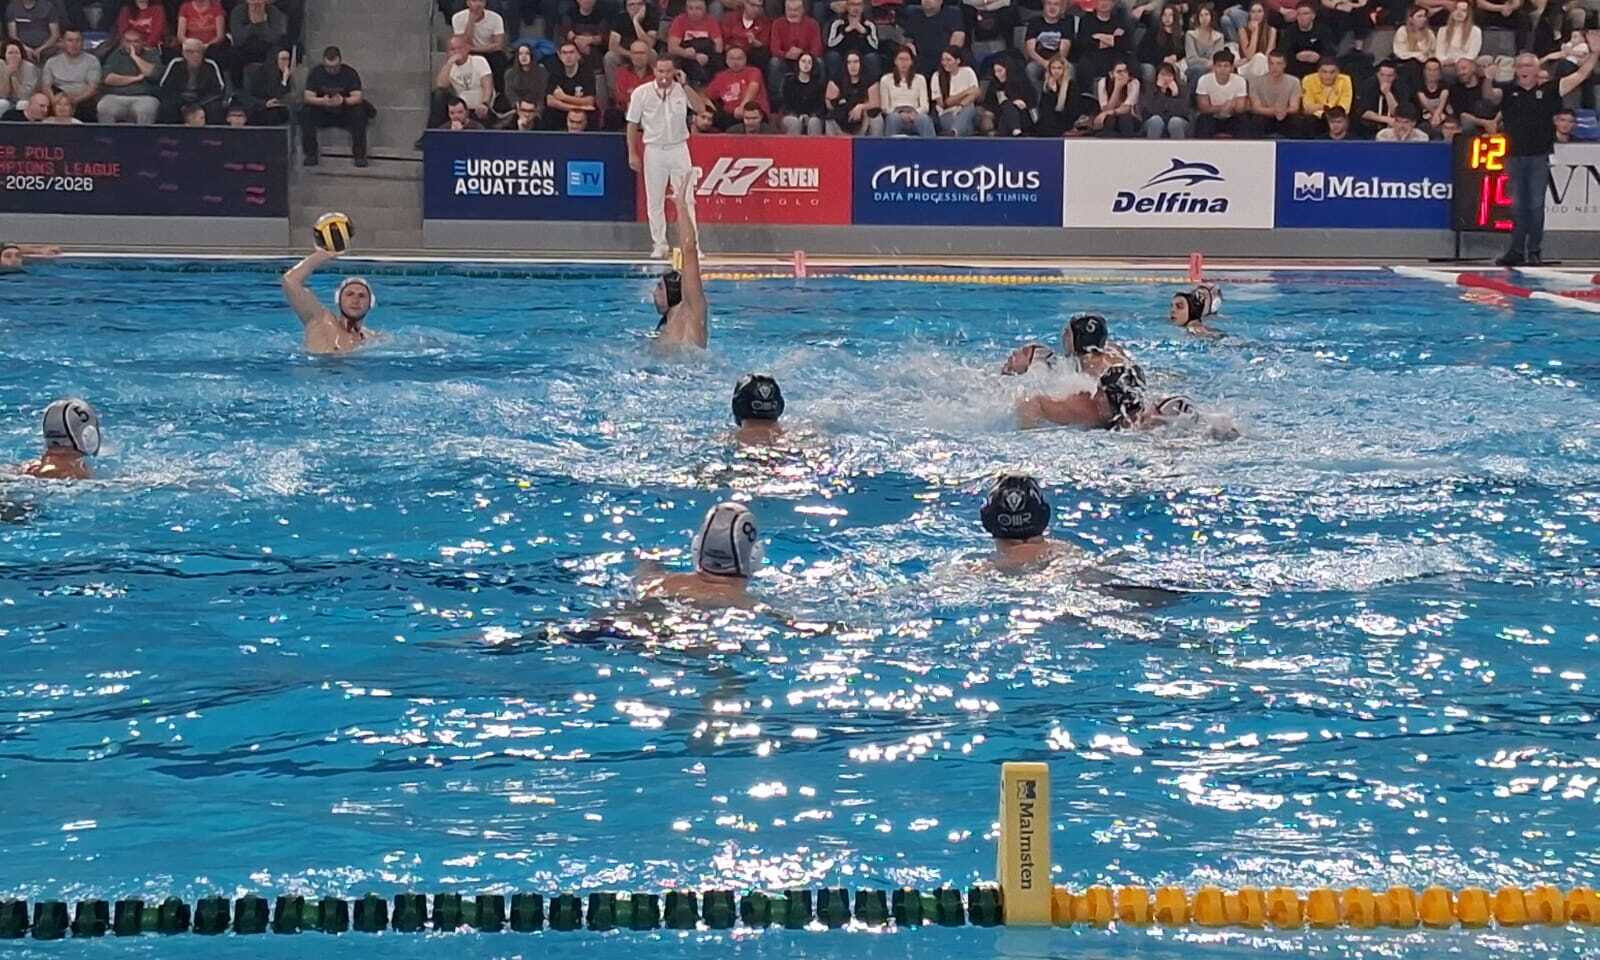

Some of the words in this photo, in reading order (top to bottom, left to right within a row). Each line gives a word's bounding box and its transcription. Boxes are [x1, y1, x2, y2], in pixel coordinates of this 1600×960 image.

[25, 147, 64, 160] POLO
[64, 163, 120, 176] LEAGUE
[454, 159, 554, 177] EUROPEAN
[767, 167, 819, 187] SEVEN
[6, 175, 94, 191] 2025/2026
[872, 163, 1040, 202] Microplus
[873, 192, 904, 201] DATA
[907, 192, 978, 202] PROCESSING
[997, 193, 1038, 202] TIMING
[1112, 191, 1229, 213] Delfina
[1086, 319, 1098, 333] 5
[742, 521, 757, 543] 8
[1020, 802, 1036, 890] Malmsten
